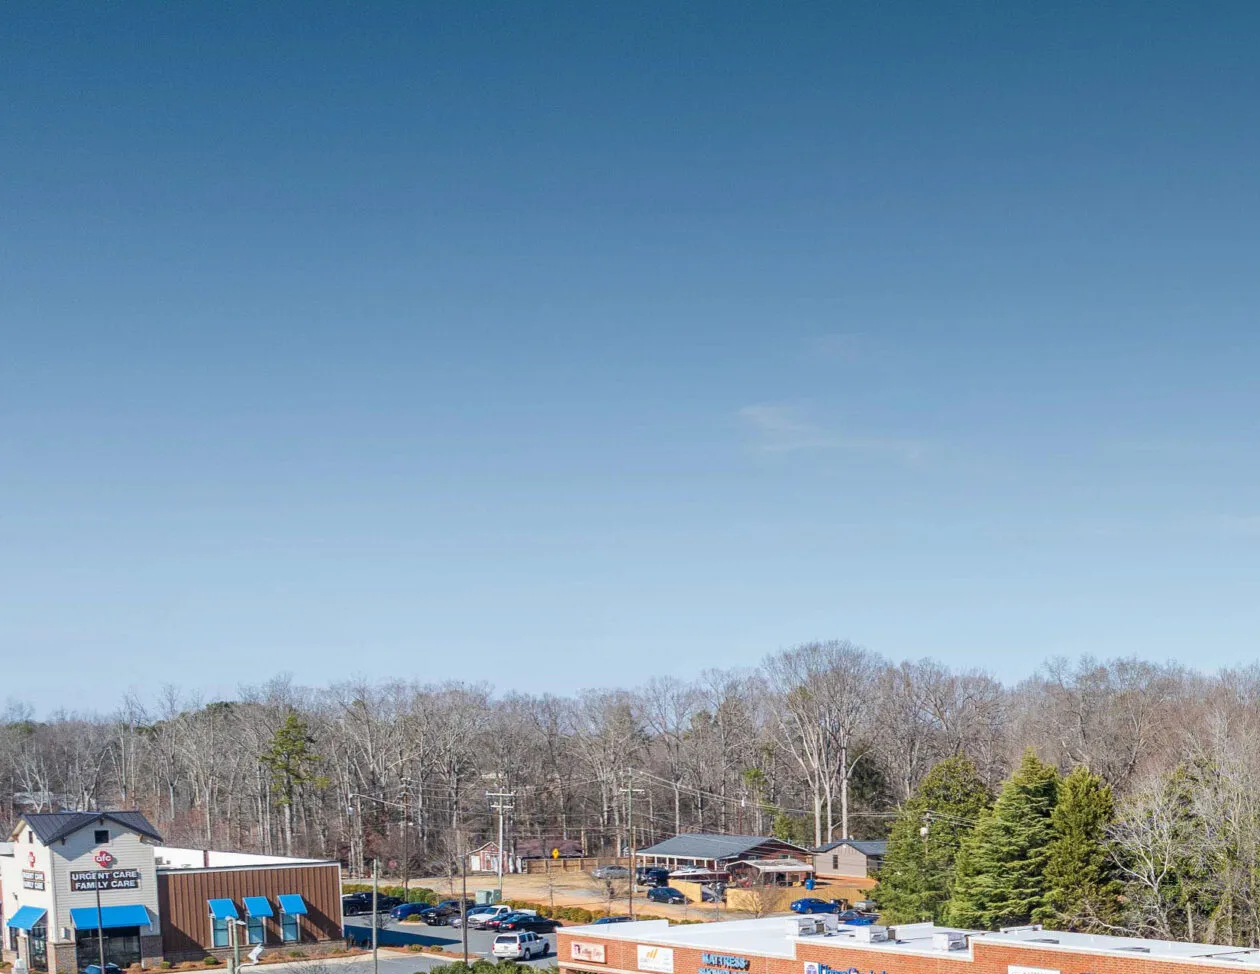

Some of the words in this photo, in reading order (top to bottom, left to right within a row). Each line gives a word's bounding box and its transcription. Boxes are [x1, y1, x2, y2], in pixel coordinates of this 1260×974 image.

[72, 872, 110, 880] URGENT
[113, 870, 137, 879] CARE
[75, 881, 109, 890] FAMLY
[111, 879, 136, 888] CARE
[701, 953, 748, 970] MATTRESS
